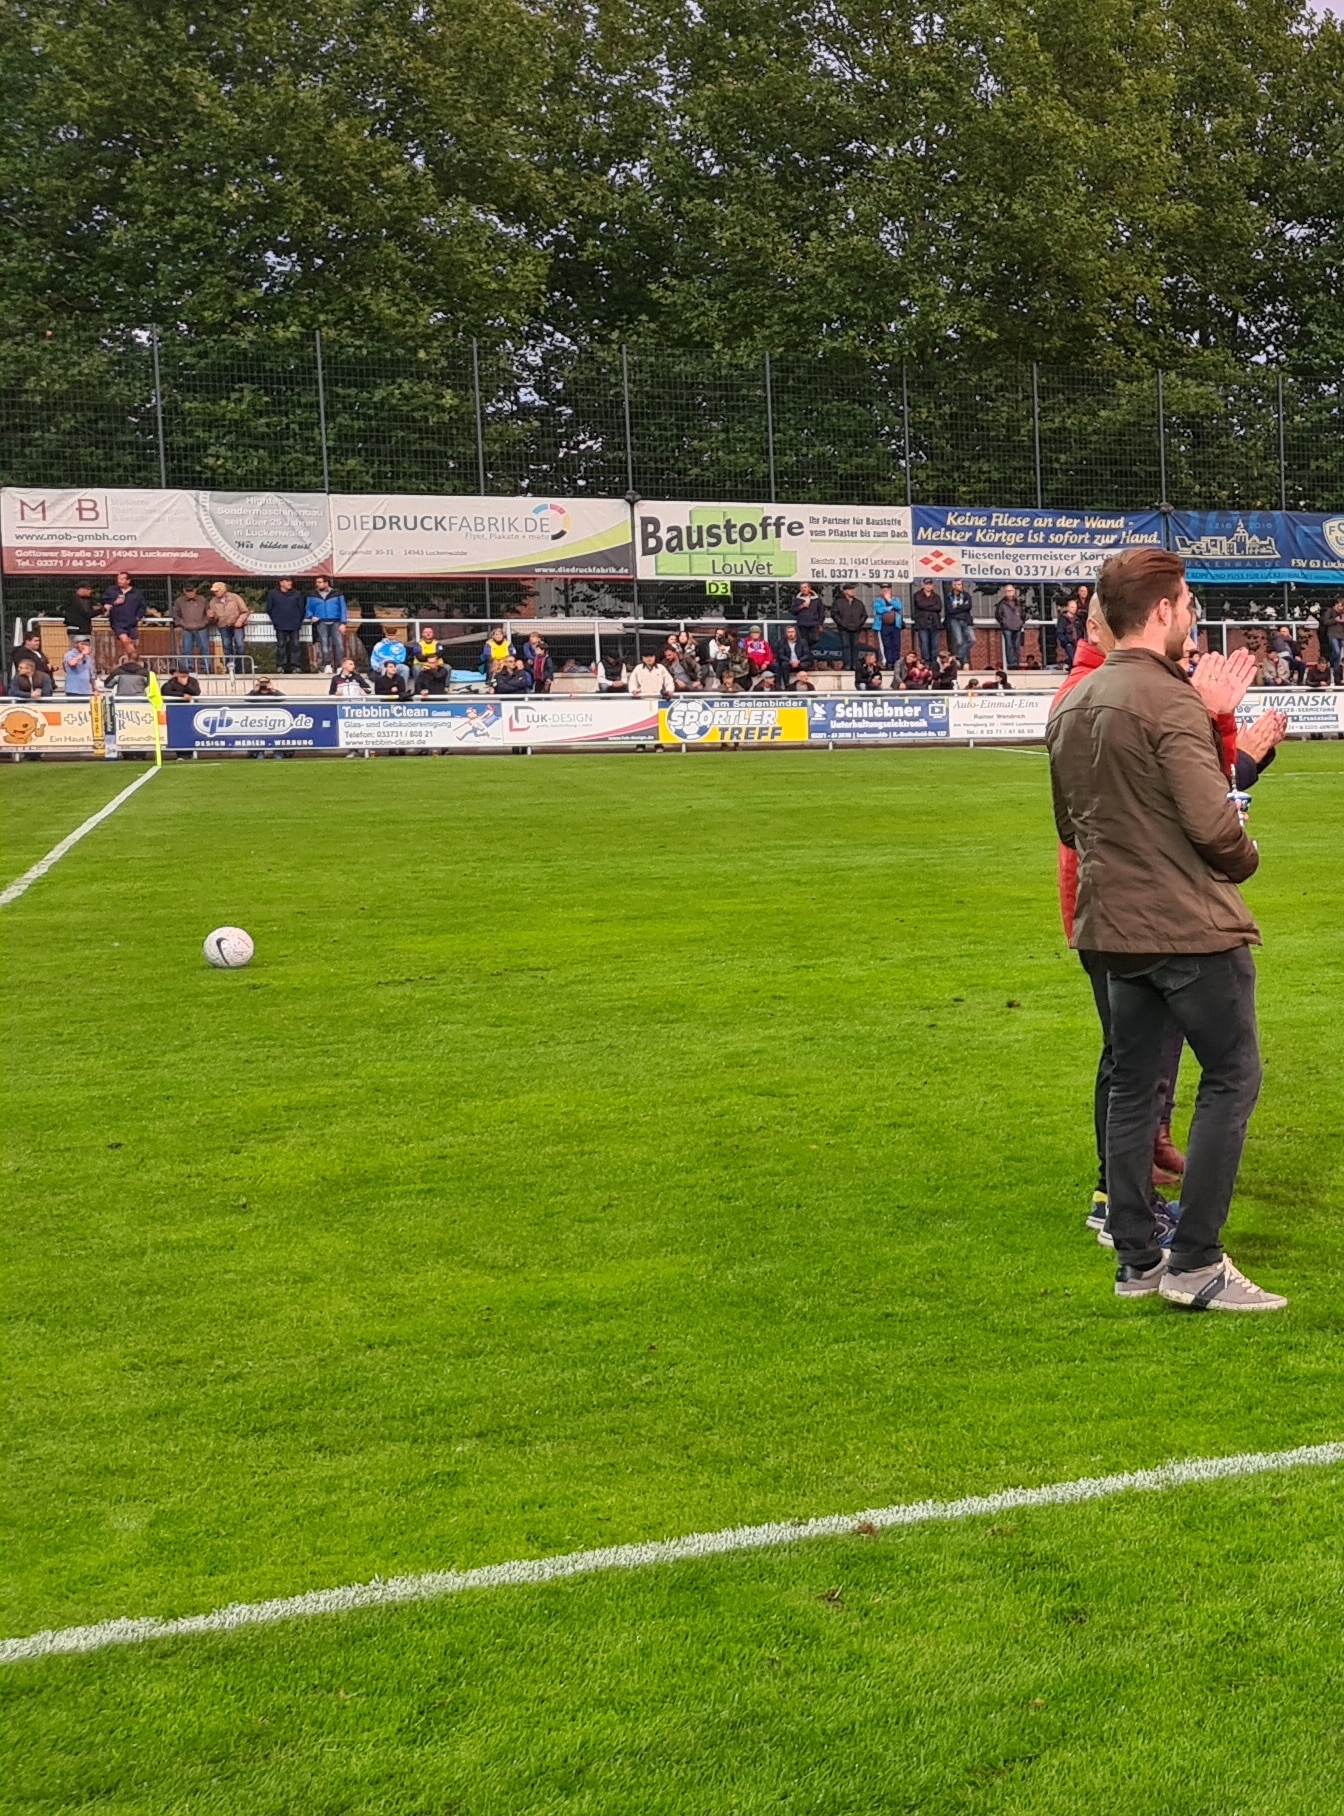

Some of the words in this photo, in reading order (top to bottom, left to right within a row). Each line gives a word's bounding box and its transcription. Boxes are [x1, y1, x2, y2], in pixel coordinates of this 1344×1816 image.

[337, 514, 550, 533] DIEDRUCKFABRIK.DE
[822, 516, 850, 525] Partner
[853, 517, 863, 525] für
[865, 517, 902, 526] Baustoffe
[946, 512, 987, 526] Keine
[990, 513, 1030, 527] Fliese
[1033, 516, 1053, 527] an
[1056, 514, 1080, 528] der
[1084, 516, 1125, 528] Wand
[14, 531, 137, 542] www.mob-gmbh.com
[640, 515, 804, 557] Baustoffe
[828, 529, 858, 538] Pflaster
[860, 529, 871, 538] bis
[891, 530, 908, 538] Dach
[917, 527, 972, 542] Meister
[975, 528, 1024, 546] Körtge
[1027, 530, 1045, 543] ist
[1048, 529, 1090, 545] sofort
[1094, 534, 1117, 545] zur
[1121, 531, 1161, 544] Hand.
[140, 551, 199, 560] Luckenwalde
[961, 550, 1075, 562] Fliesenlegermeister
[711, 559, 773, 575] LouVet
[1291, 559, 1308, 567] FSV
[534, 566, 629, 575] www.diedruckfabrik.de
[811, 568, 828, 578] Tel.
[830, 568, 859, 578] 03371
[868, 569, 881, 578] 59
[883, 569, 895, 578] 73
[897, 569, 909, 579] 40
[961, 564, 1011, 575] Telefon
[1065, 565, 1079, 575] 64
[708, 583, 729, 594] D3
[733, 700, 803, 708] Seelenbinder
[953, 699, 1039, 709] Auto-Einmal-Eins
[1262, 695, 1337, 706] IWANSKI
[342, 705, 390, 718] Trebbin
[394, 705, 428, 717] Clean
[835, 702, 922, 718] Schliebner
[527, 713, 593, 723] LUK-DESIGN
[670, 710, 778, 727] SPORTLER
[830, 720, 928, 729] Unterhaltungselektronik
[719, 727, 782, 740] TREFF
